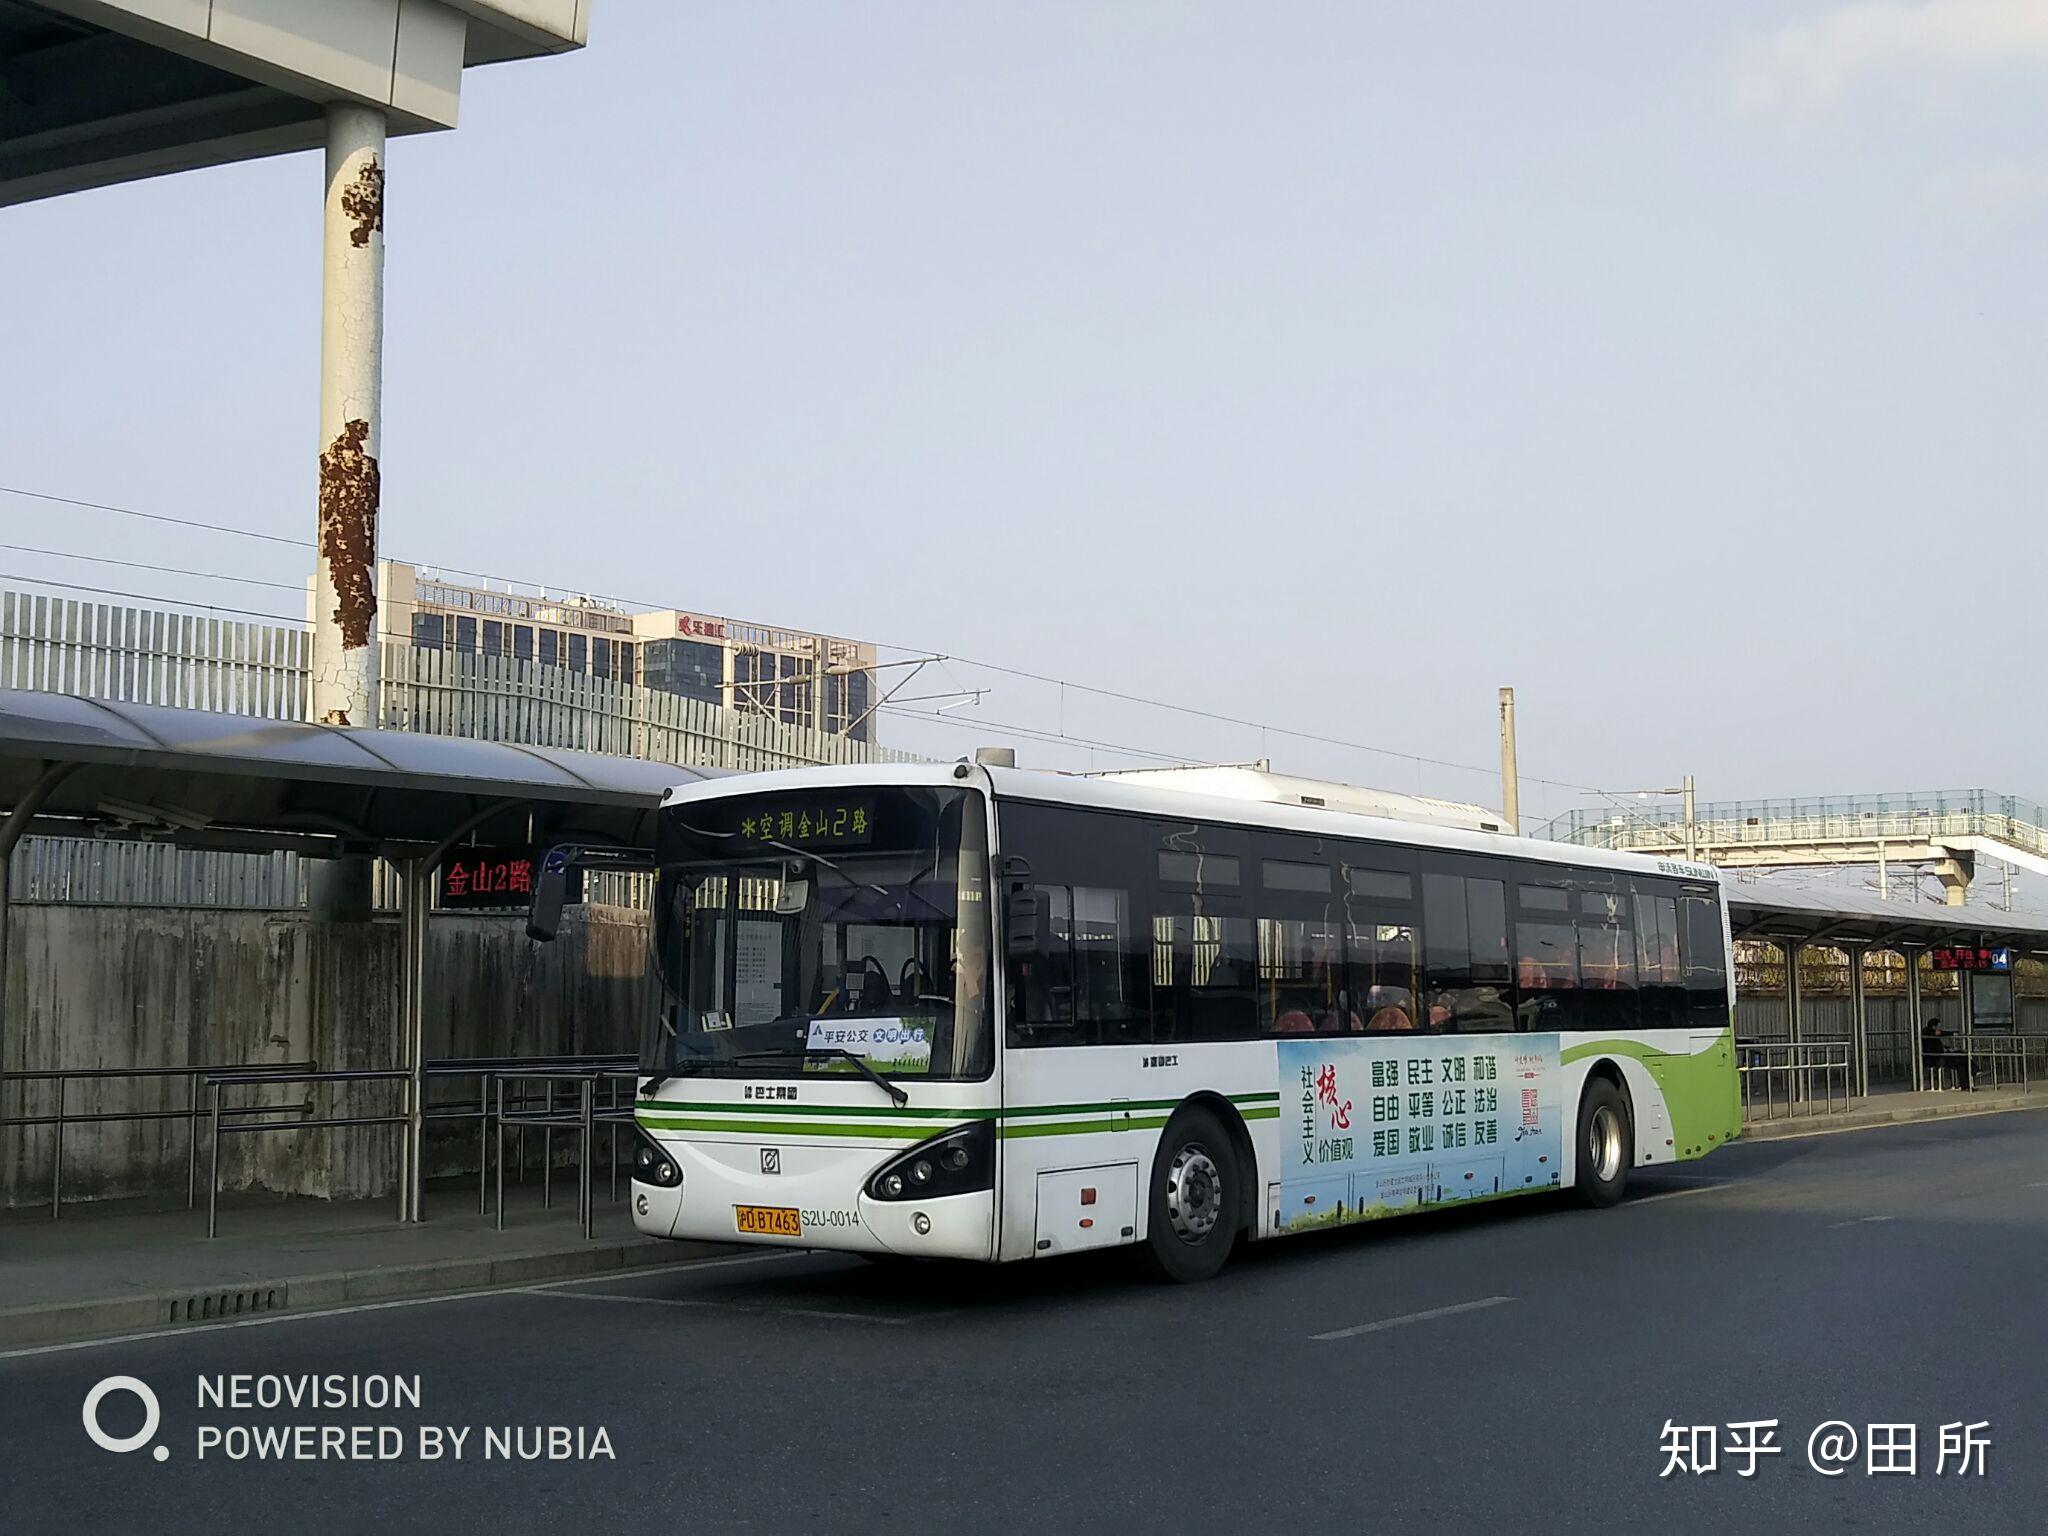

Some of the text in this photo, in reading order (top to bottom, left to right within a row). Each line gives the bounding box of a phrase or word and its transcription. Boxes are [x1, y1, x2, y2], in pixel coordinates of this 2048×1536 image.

[760, 807, 868, 840] 空调金山2路
[446, 860, 532, 896] 金山2路
[824, 1028, 925, 1043] 平安公交 文明出行
[1371, 1060, 1399, 1087] 富强
[1407, 1058, 1433, 1085] 民主
[1441, 1057, 1466, 1083] 文明
[1473, 1056, 1497, 1081] 和谐
[1317, 1064, 1352, 1130] 核心
[1373, 1094, 1399, 1122] 自由
[1408, 1091, 1434, 1119] 平等
[1442, 1089, 1466, 1116] 公正
[1474, 1087, 1497, 1113] 法治
[1301, 1065, 1314, 1165] 社会主义
[1319, 1137, 1353, 1163] 价值观
[1373, 1119, 1497, 1157] 爱国 敬业 诚信 友善
[801, 1210, 860, 1226] S2U-0014
